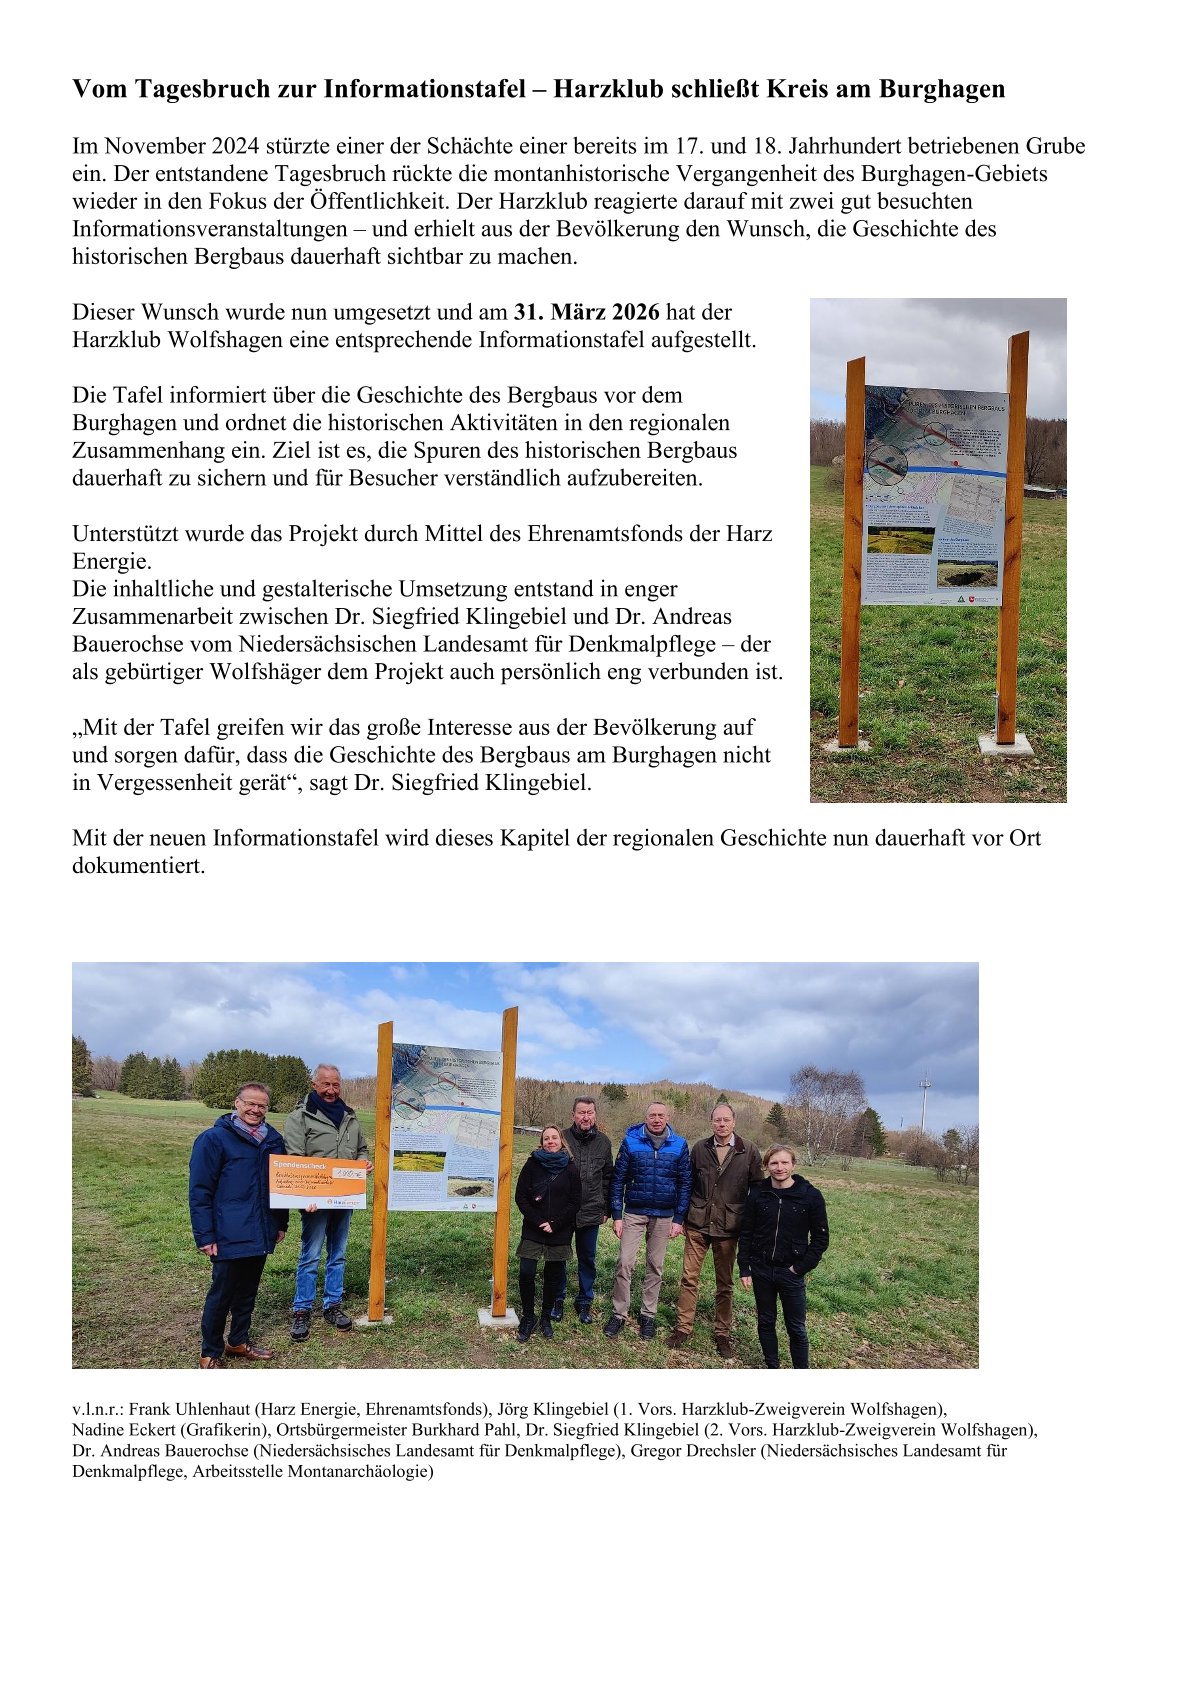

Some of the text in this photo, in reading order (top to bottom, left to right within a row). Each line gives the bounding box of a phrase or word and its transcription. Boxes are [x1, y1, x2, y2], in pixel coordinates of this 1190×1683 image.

[71, 78, 128, 99] Vom
[134, 78, 271, 104] Tagesbruch
[277, 83, 318, 99] zur
[323, 78, 526, 99] Informationstafel
[553, 78, 664, 99] Harzklub
[671, 78, 760, 99] schließt
[766, 78, 829, 99] Kreis
[836, 83, 871, 99] am
[878, 78, 1006, 104] Burghagen
[72, 136, 1086, 155] Im November 2024 stürzte einer der Schächte einer bereits im 17. und 18. Jahrhundert betriebenen Grube
[72, 163, 1048, 187] ein. Der entstandene Tagesbruch rückte die montanhistorische Vergangenheit des Burghagen-Gebiets
[72, 302, 733, 326] Dieser Wunsch wurde nun umgesetzt und am 31. März 2026 hat der
[72, 329, 756, 353] Harzklub Wolfshagen eine entsprechende Informationstafel aufgestellt.
[72, 412, 731, 436] Burghagen und ordnet die historischen Aktivitäten in den regionalen
[72, 551, 152, 575] Energie.
[71, 606, 732, 630] Zusammenarbeit zwischen Dr. Siegfried Klingebiel und Dr. Andreas
[72, 661, 783, 685] als gebürtiger Wolfshäger dem Projekt auch persönlich eng verbunden ist.
[72, 772, 592, 796] in Vergessenheit gerät“, sagt Dr. Siegfried Klingebiel.
[72, 828, 1042, 852] Mit der neuen Informationstafel wird dieses Kapitel der regionalen Geschichte nun dauerhaft vor Ort
[72, 855, 205, 874] dokumentiert.
[273, 1160, 327, 1170] Spendenscheck
[72, 1401, 948, 1420] v.l.n.r.: Frank Uhlenhaut (Harz Energie, Ehrenamtsfonds), Jörg Klingebiel (1. Vors. Harzklub-Zweigverein Wolfshagen),
[71, 1422, 1038, 1440] Nadine Eckert (Grafikerin), Ortsbürgermeister Burkhard Pahl, Dr. Siegfried Klingebiel (2. Vors. Harzklub-Zweigverein Wolfshagen),
[72, 1443, 1008, 1461] Dr. Andreas Bauerochse (Niedersächsisches Landesamt für Denkmalpflege), Gregor Drechsler (Niedersächsisches Landesamt für
[72, 1463, 434, 1482] Denkmalpflege, Arbeitsstelle Montanarchäologie)
